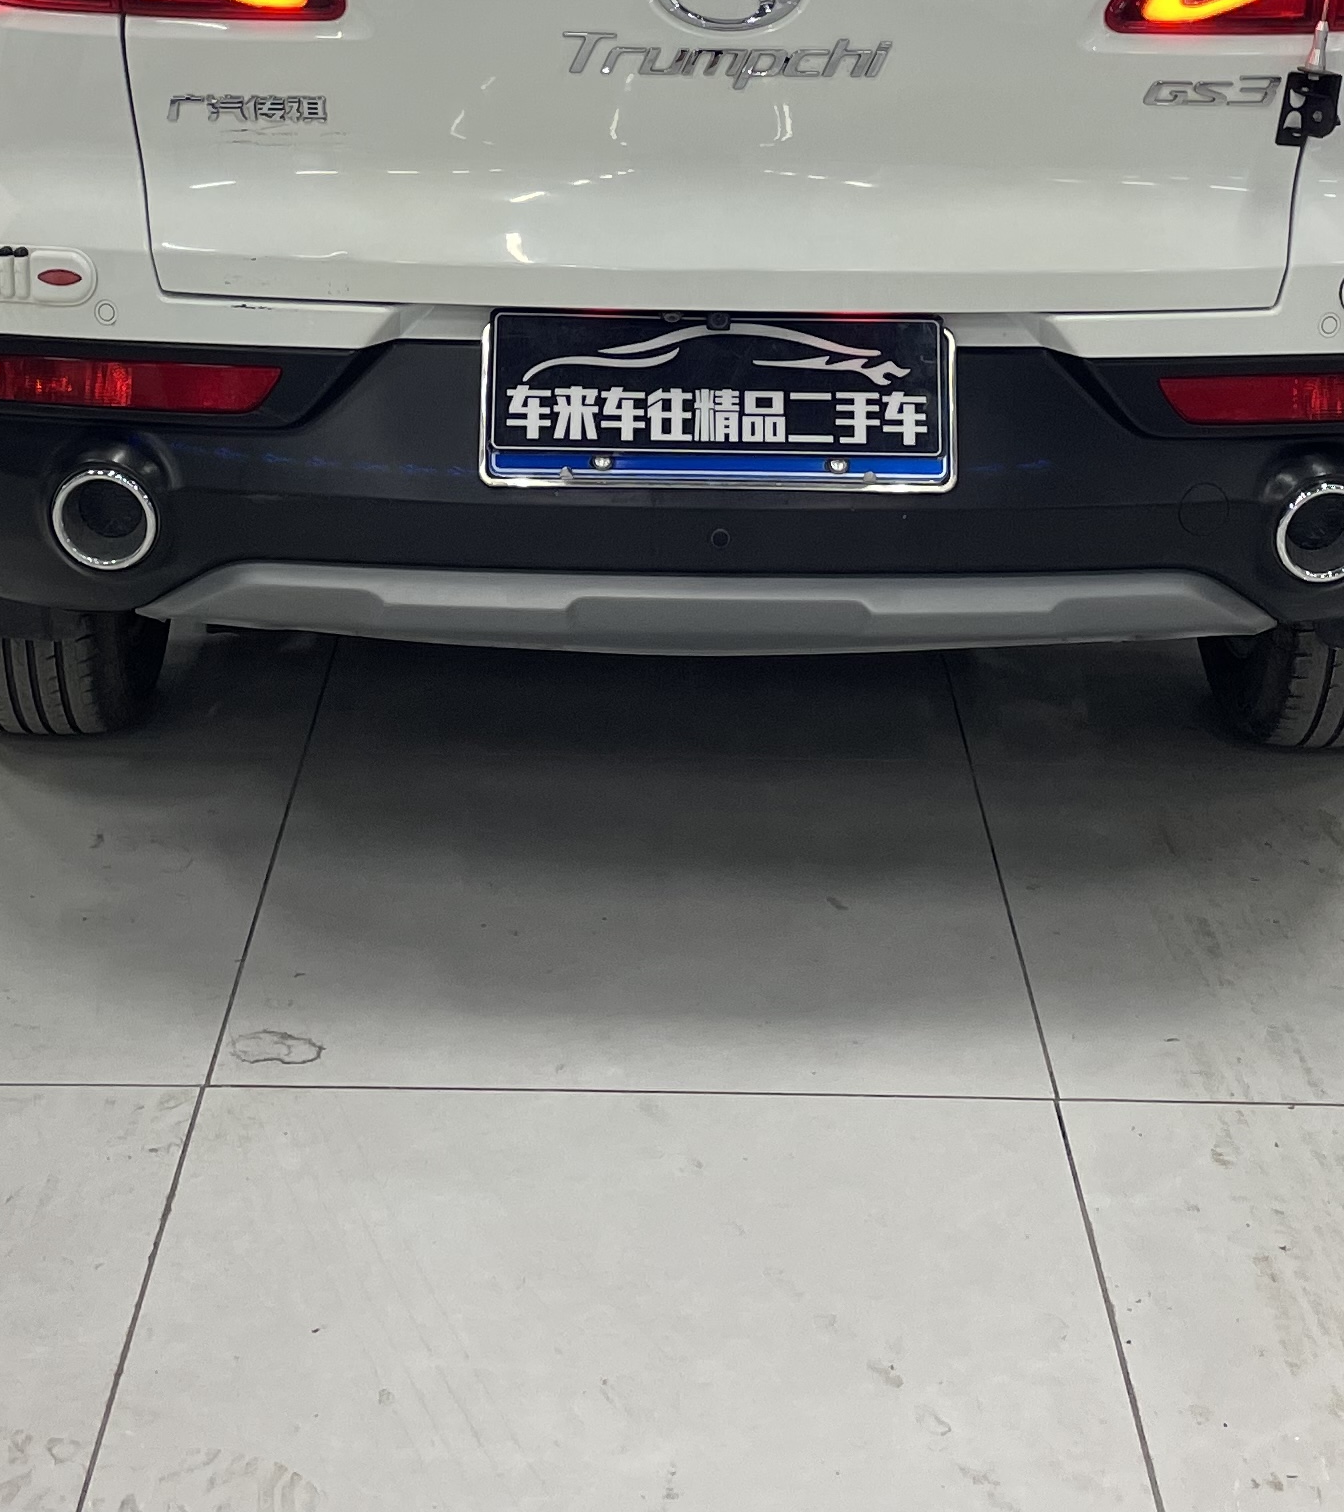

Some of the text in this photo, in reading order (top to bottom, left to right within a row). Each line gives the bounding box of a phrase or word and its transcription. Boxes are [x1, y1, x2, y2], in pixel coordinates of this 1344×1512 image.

[562, 30, 893, 90] Trumpchi
[167, 94, 328, 123] 广汽传祺
[1142, 75, 1283, 107] GS3
[505, 384, 929, 446] 车来车往精品二手车
